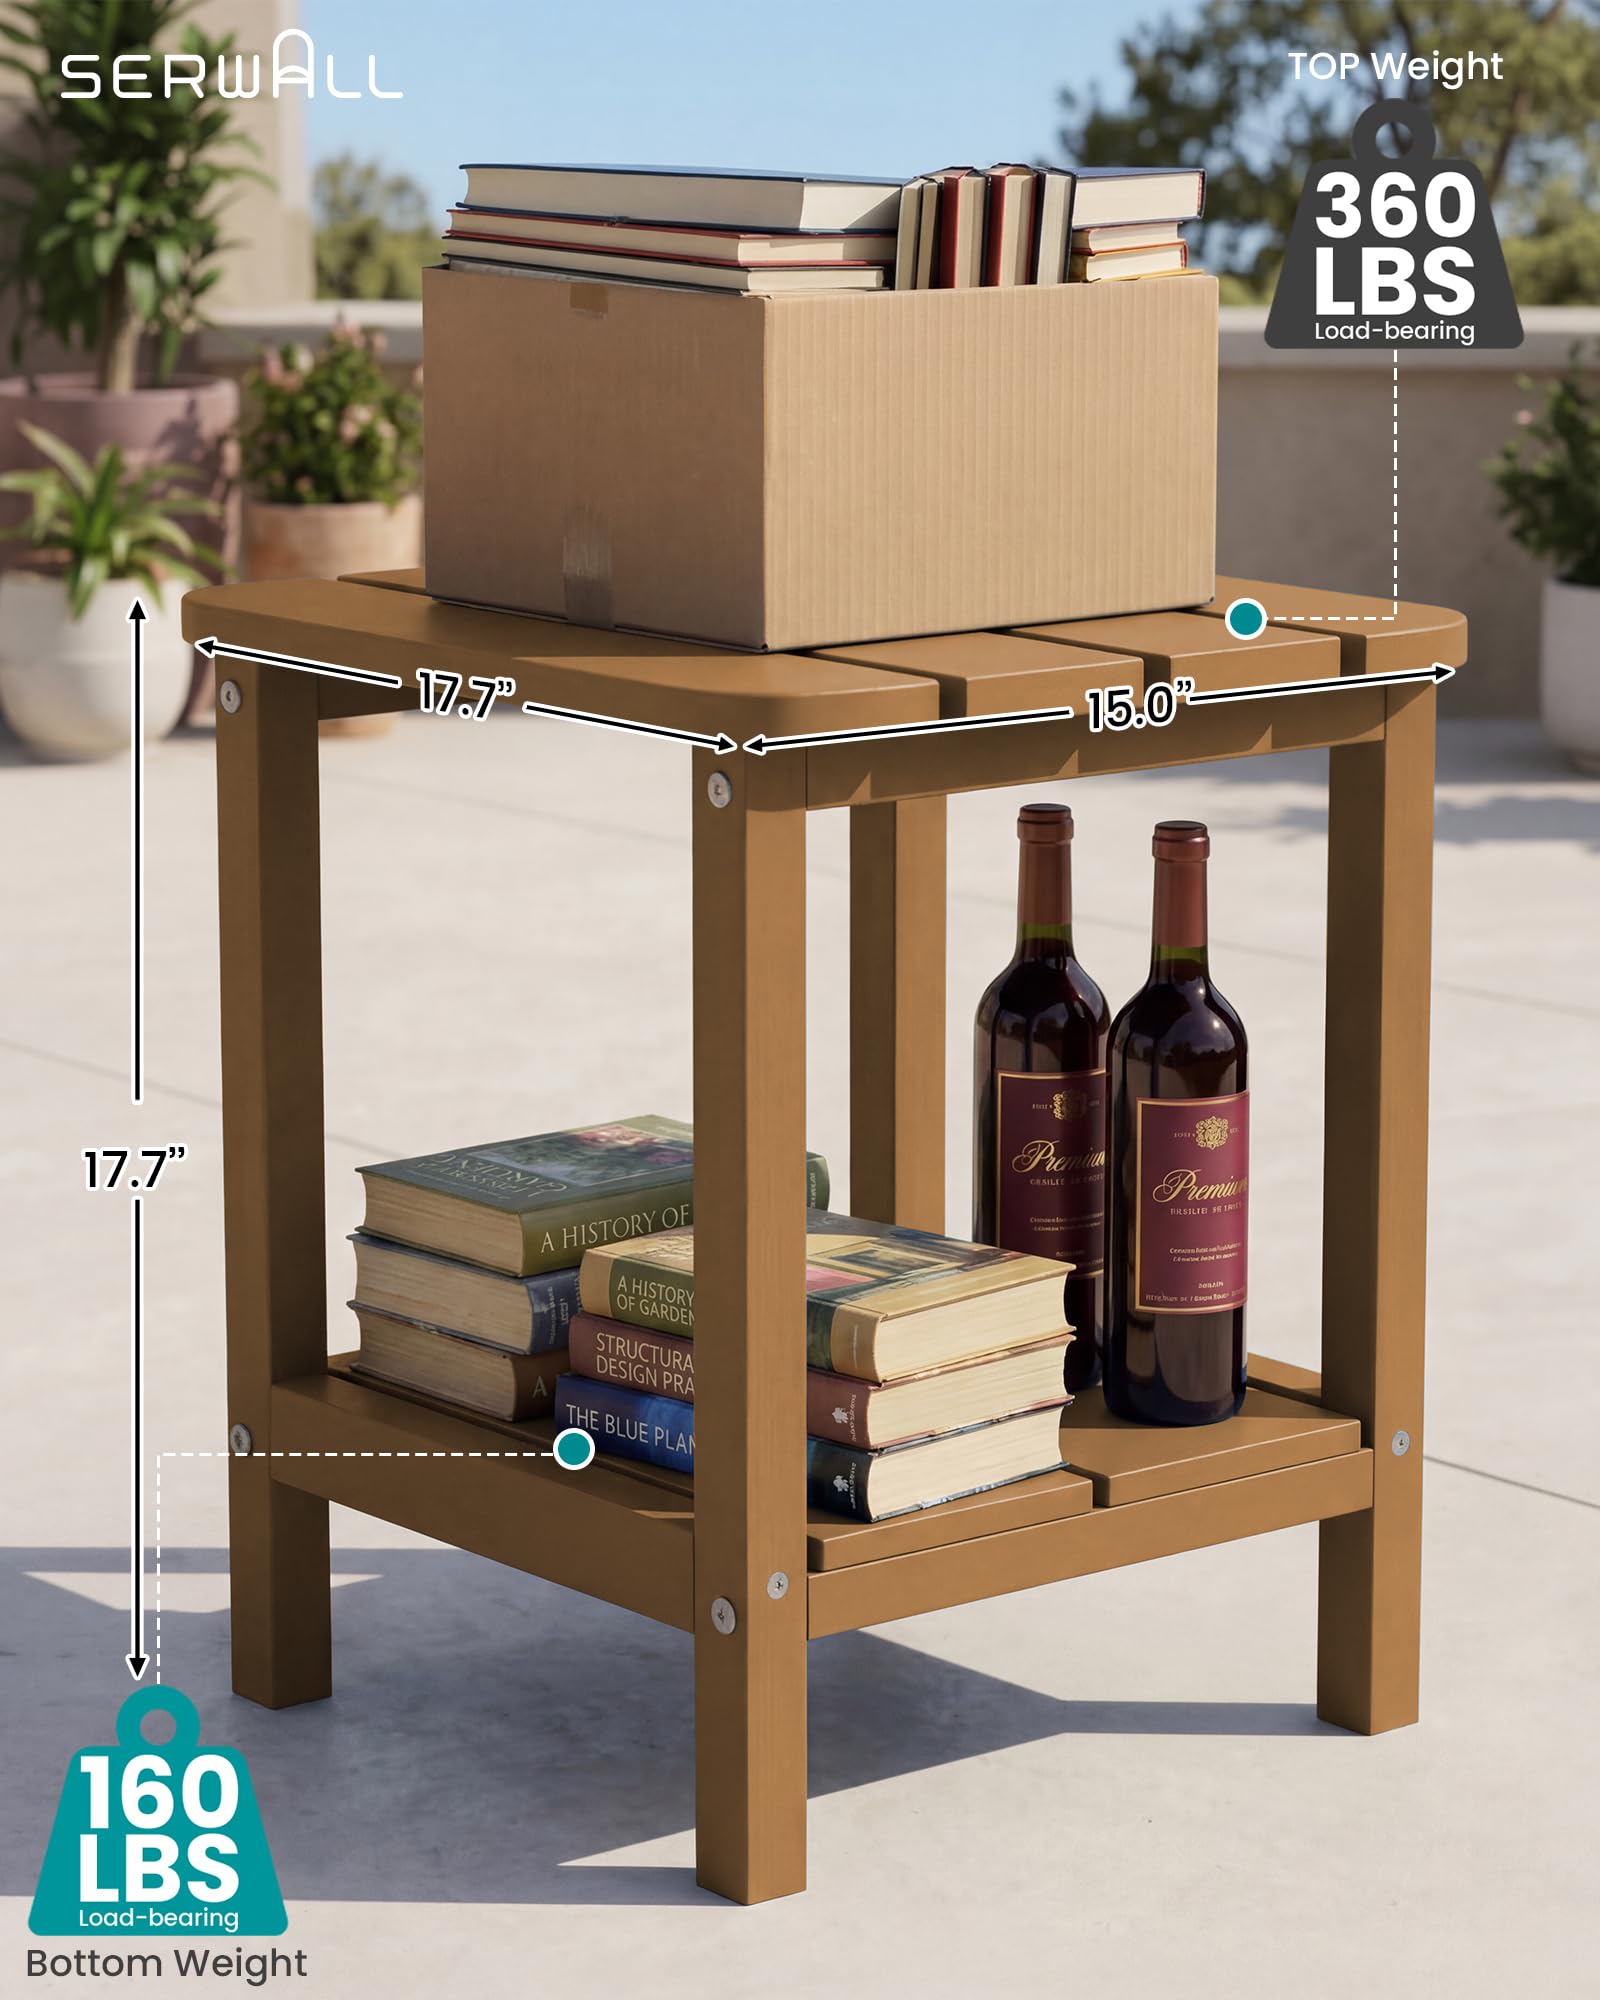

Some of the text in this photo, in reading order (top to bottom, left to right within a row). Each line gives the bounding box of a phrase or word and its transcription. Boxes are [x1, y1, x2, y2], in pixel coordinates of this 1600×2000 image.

[541, 1203, 690, 1253] A HISTORY OF
[616, 1293, 636, 1312] OF
[617, 1275, 695, 1307] A HISTORY
[596, 1332, 695, 1374] STRUCTURA
[532, 1375, 548, 1398] A
[596, 1355, 695, 1396] DESIGN PRA
[566, 1403, 600, 1431] THE
[605, 1413, 649, 1444] BLUE
